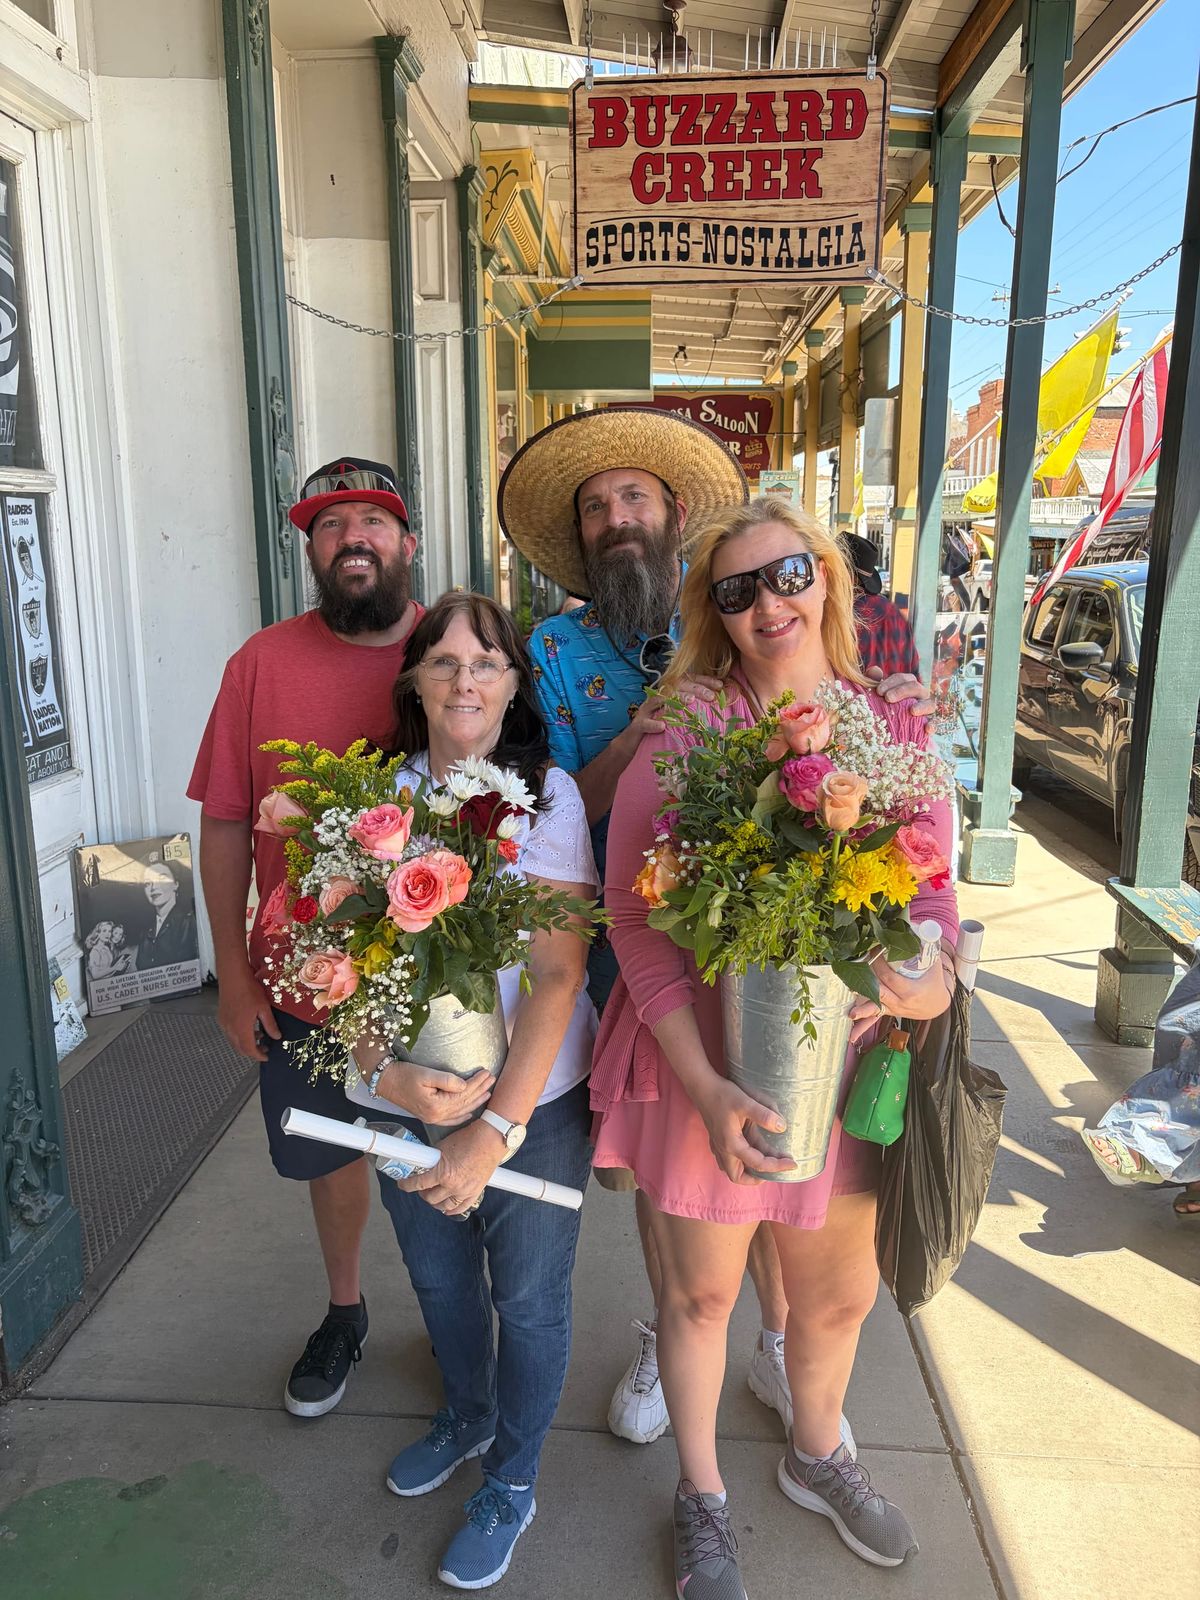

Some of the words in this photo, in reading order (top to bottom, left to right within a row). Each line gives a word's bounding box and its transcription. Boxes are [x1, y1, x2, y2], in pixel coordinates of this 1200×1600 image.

[588, 88, 869, 149] BUZZARD
[629, 148, 824, 205] CREEK
[586, 221, 866, 269] SPORTS-NOSTALGIA
[8, 504, 33, 515] RAIDERS
[33, 703, 58, 720] RAIDER
[38, 714, 62, 733] NATION
[44, 746, 64, 766] AND
[37, 762, 58, 780] ABOUT
[116, 975, 136, 984] LIFETIME
[139, 970, 163, 979] EDUCATION
[165, 964, 181, 973] FREE
[121, 980, 139, 988] SCHOOL
[141, 974, 166, 984] GRADUATES
[97, 993, 113, 1003] U.S.
[114, 988, 140, 999] CADET
[143, 981, 169, 992] NURSE
[172, 974, 197, 986] CORPS
